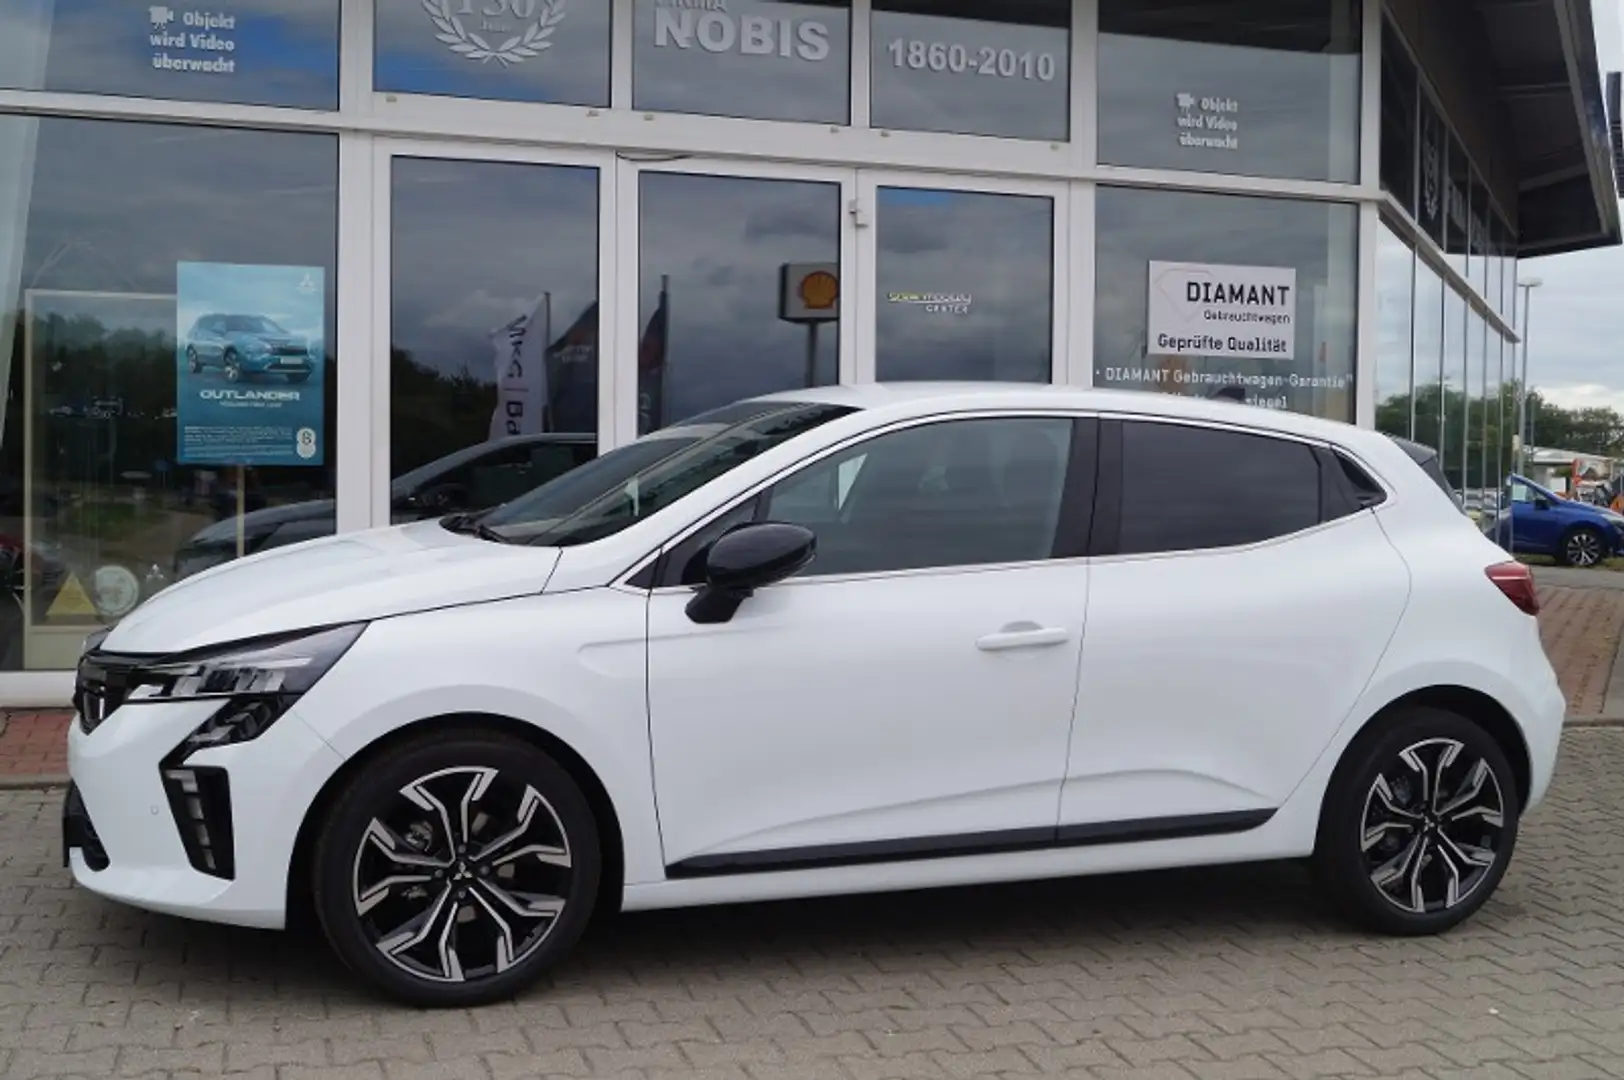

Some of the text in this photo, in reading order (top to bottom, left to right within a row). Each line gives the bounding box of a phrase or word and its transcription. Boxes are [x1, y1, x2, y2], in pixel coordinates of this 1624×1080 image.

[183, 10, 235, 31] Objekt
[150, 31, 235, 51] wird Video
[654, 8, 830, 61] NOBIS
[152, 53, 235, 73] überwacht
[888, 38, 1055, 81] 1860-2010
[1201, 97, 1238, 113] Objekt
[1177, 114, 1238, 131] wird Video
[1186, 281, 1290, 306] DIAMANT
[1203, 309, 1291, 325] Gebrauchtwagen
[1157, 333, 1288, 353] Geprüfte Qualität
[1105, 367, 1170, 382] DIAMANT
[199, 389, 301, 401] OUTLANDER
